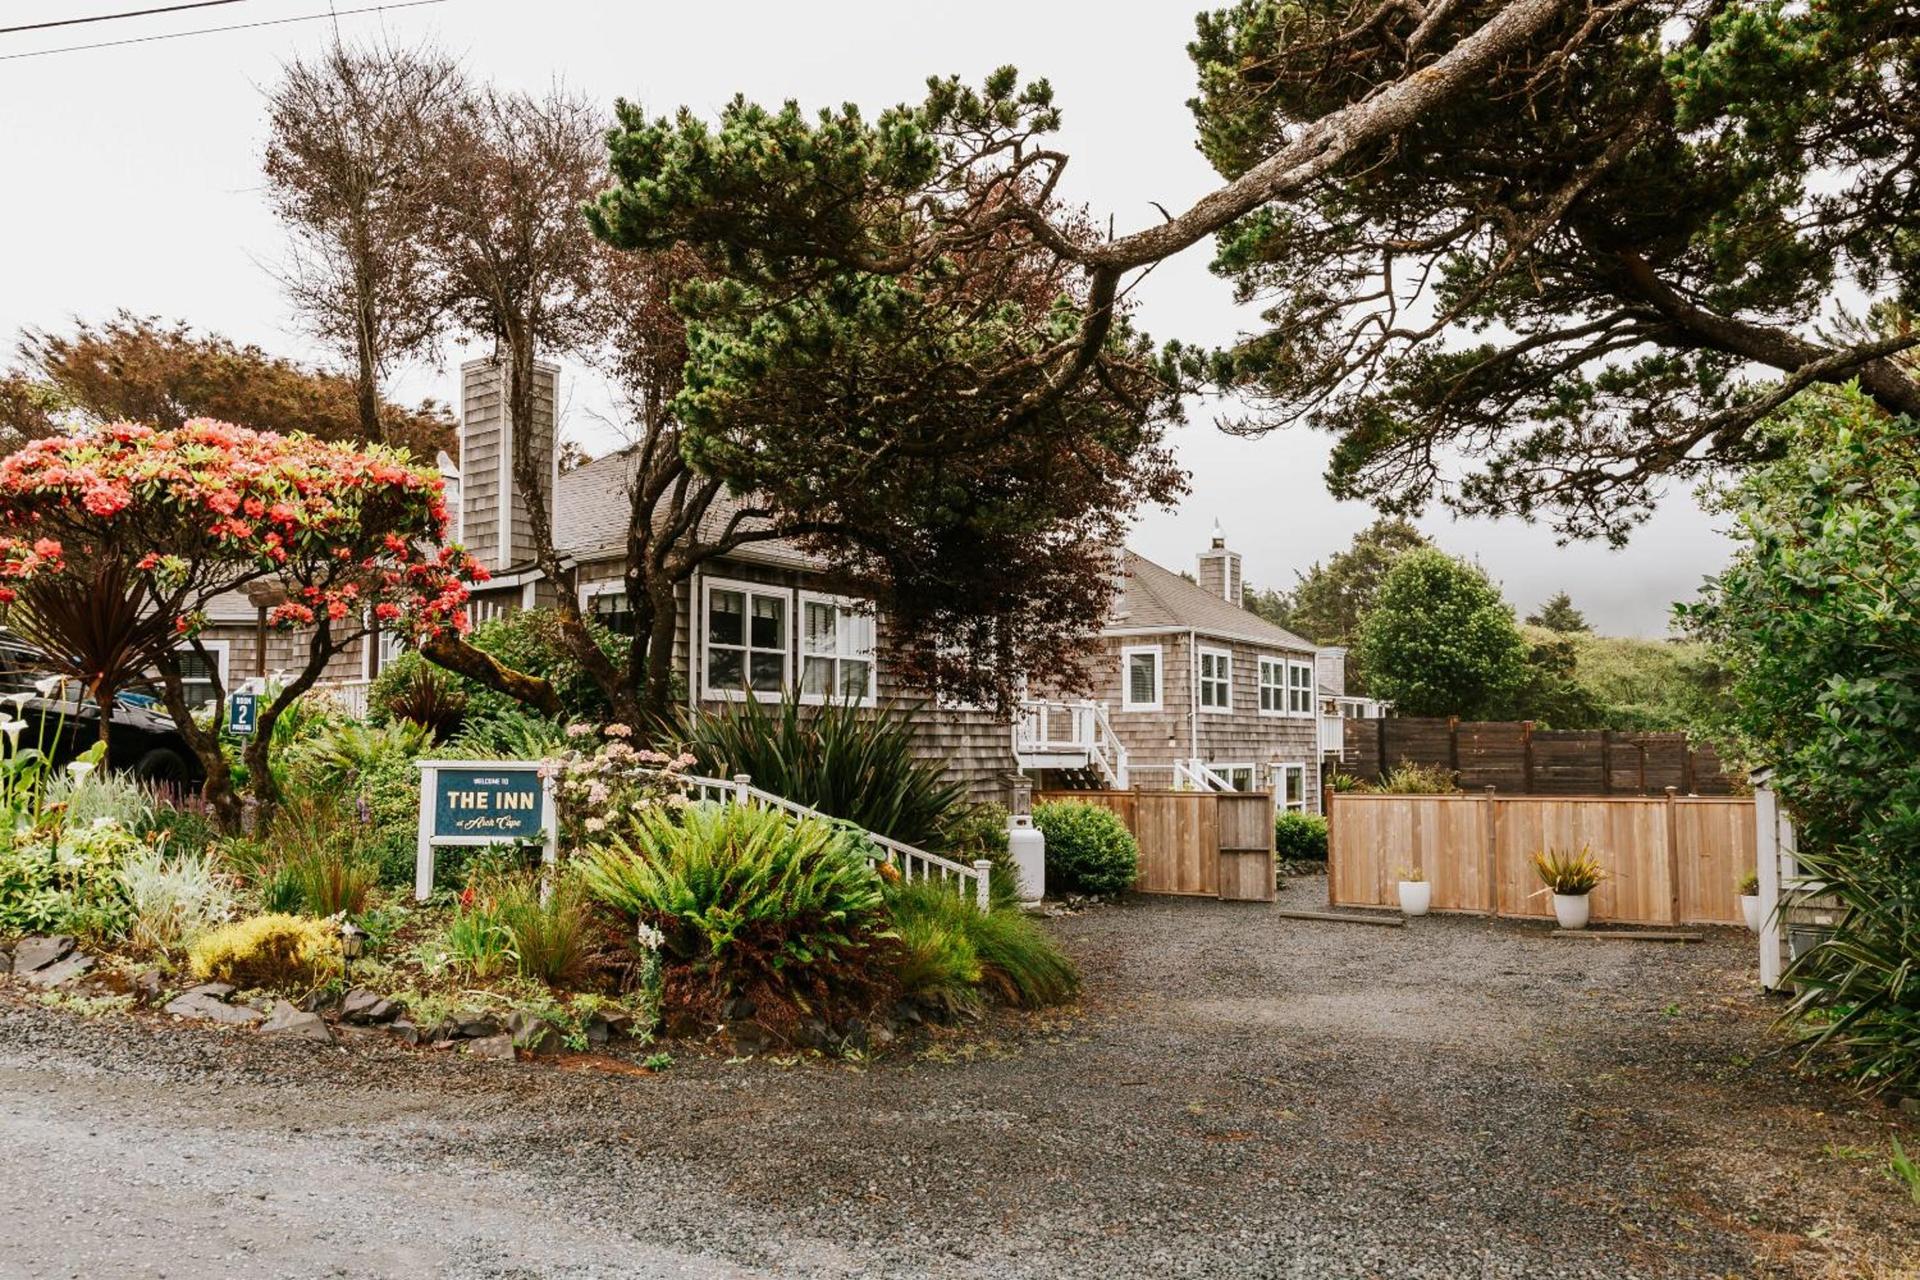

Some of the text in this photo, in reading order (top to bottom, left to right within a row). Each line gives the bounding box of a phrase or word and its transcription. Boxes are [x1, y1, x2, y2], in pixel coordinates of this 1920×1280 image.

[239, 705, 248, 724] 2
[447, 791, 534, 809] THE INN
[496, 815, 522, 829] Cape
